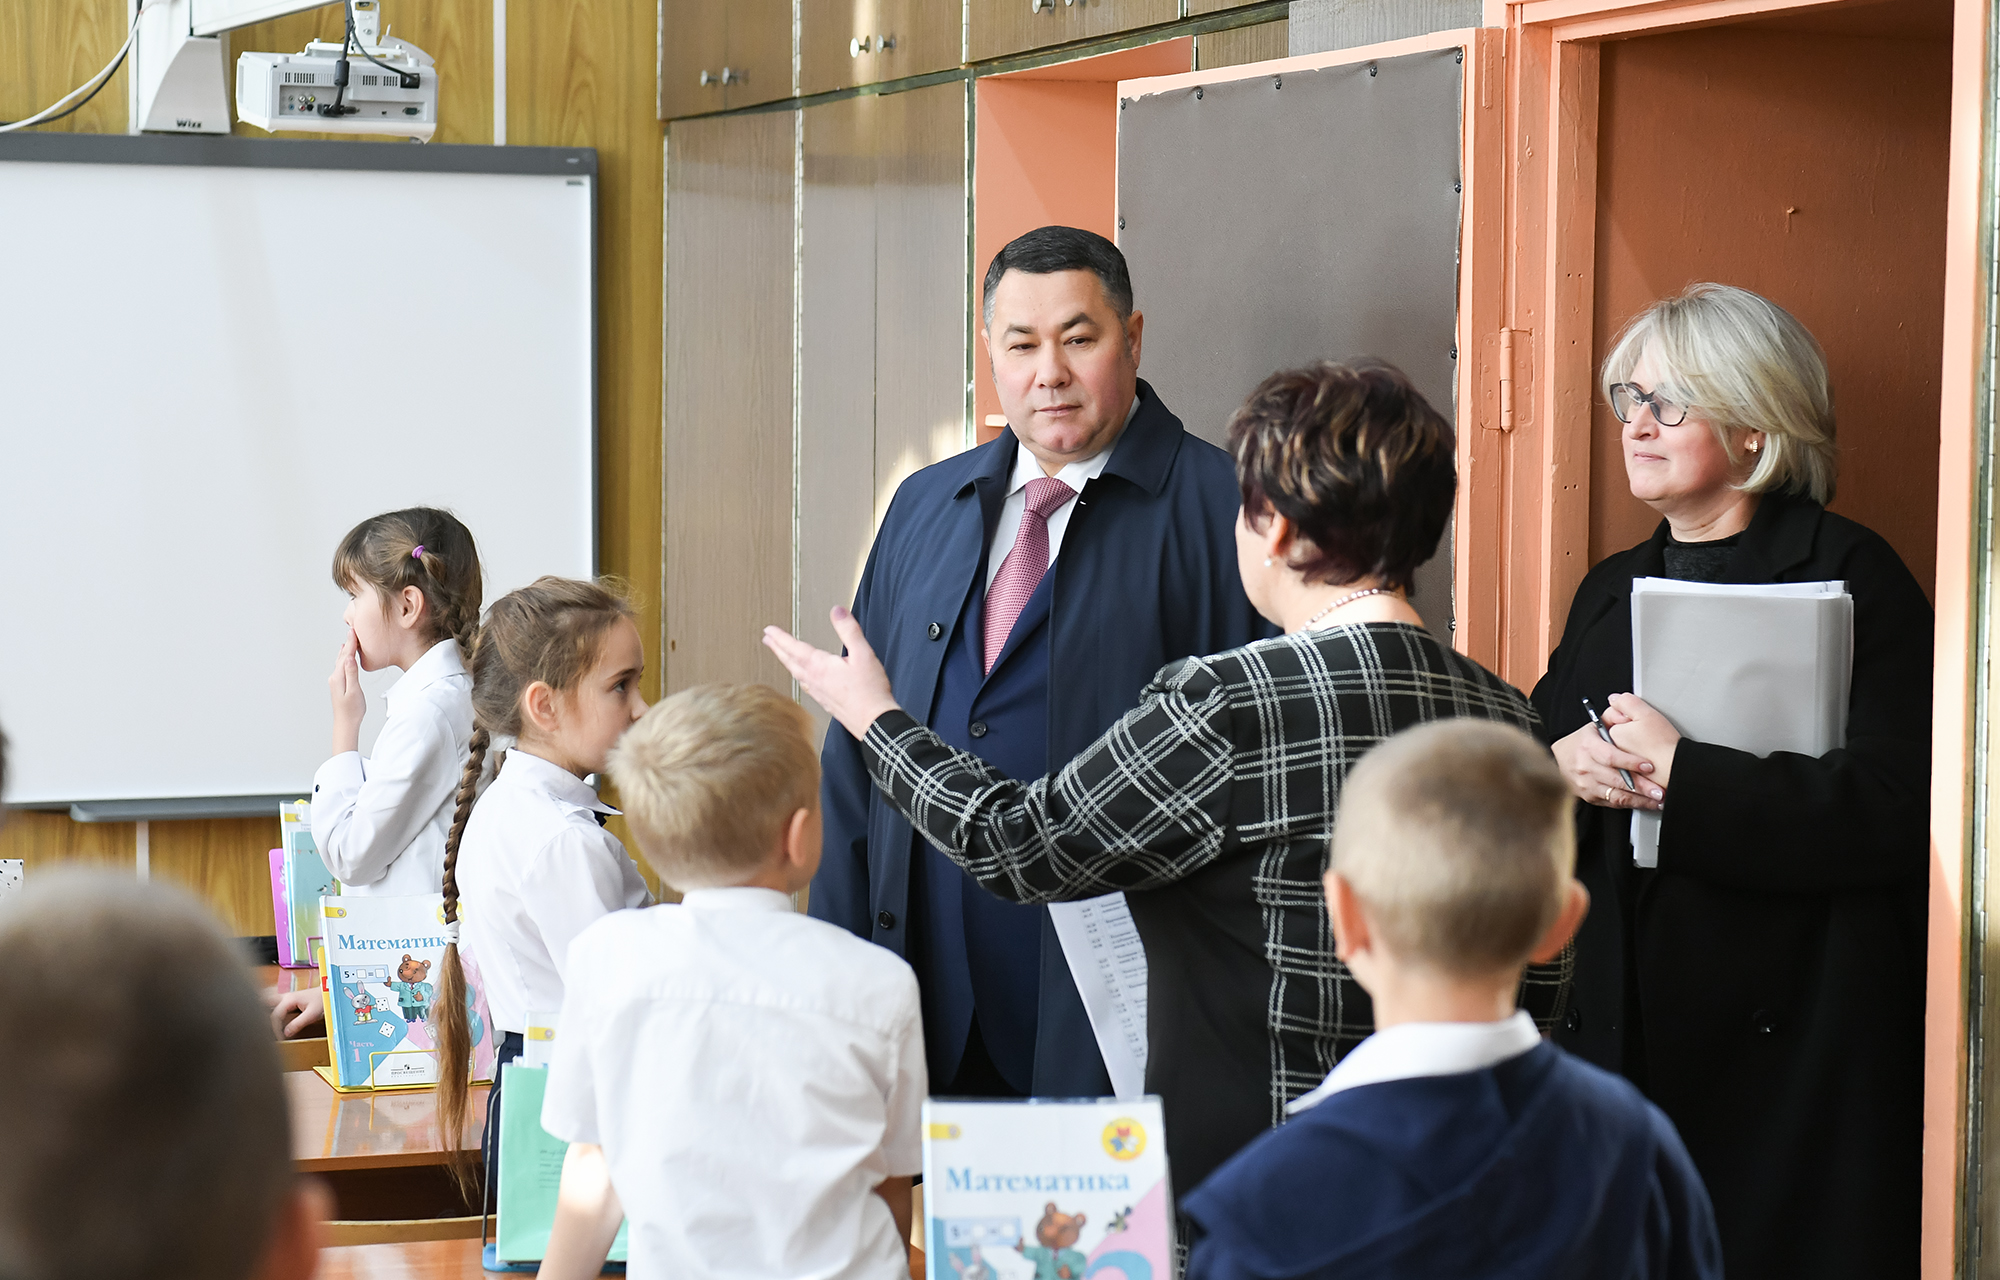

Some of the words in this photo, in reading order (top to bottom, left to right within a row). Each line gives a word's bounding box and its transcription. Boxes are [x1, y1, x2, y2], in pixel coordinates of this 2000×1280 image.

[337, 934, 447, 950] Математик
[353, 1048, 361, 1063] 1
[947, 1167, 1130, 1192] Математика
